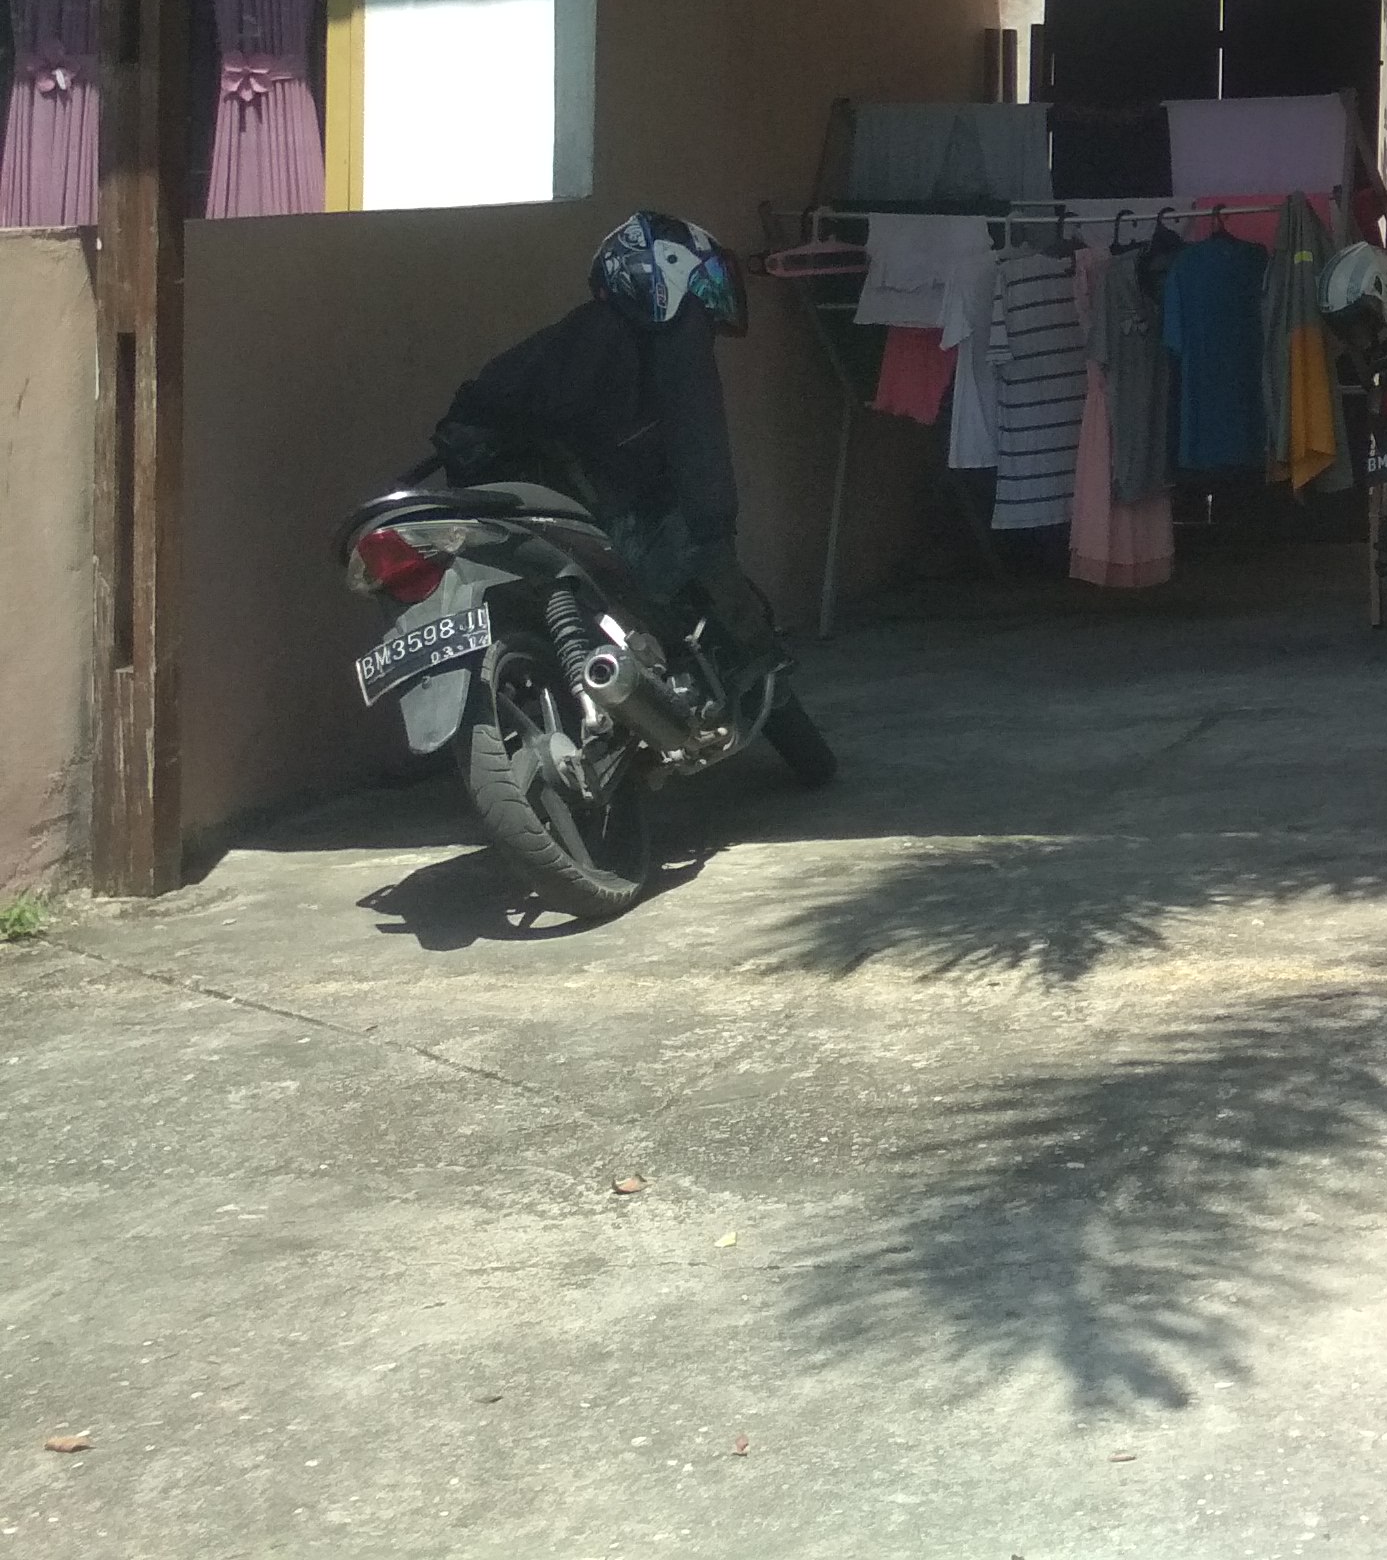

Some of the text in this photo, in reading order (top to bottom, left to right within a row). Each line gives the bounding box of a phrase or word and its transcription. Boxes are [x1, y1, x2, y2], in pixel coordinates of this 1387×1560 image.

[1368, 453, 1387, 472] BM
[361, 646, 391, 680] BM
[392, 618, 455, 660] 3598
